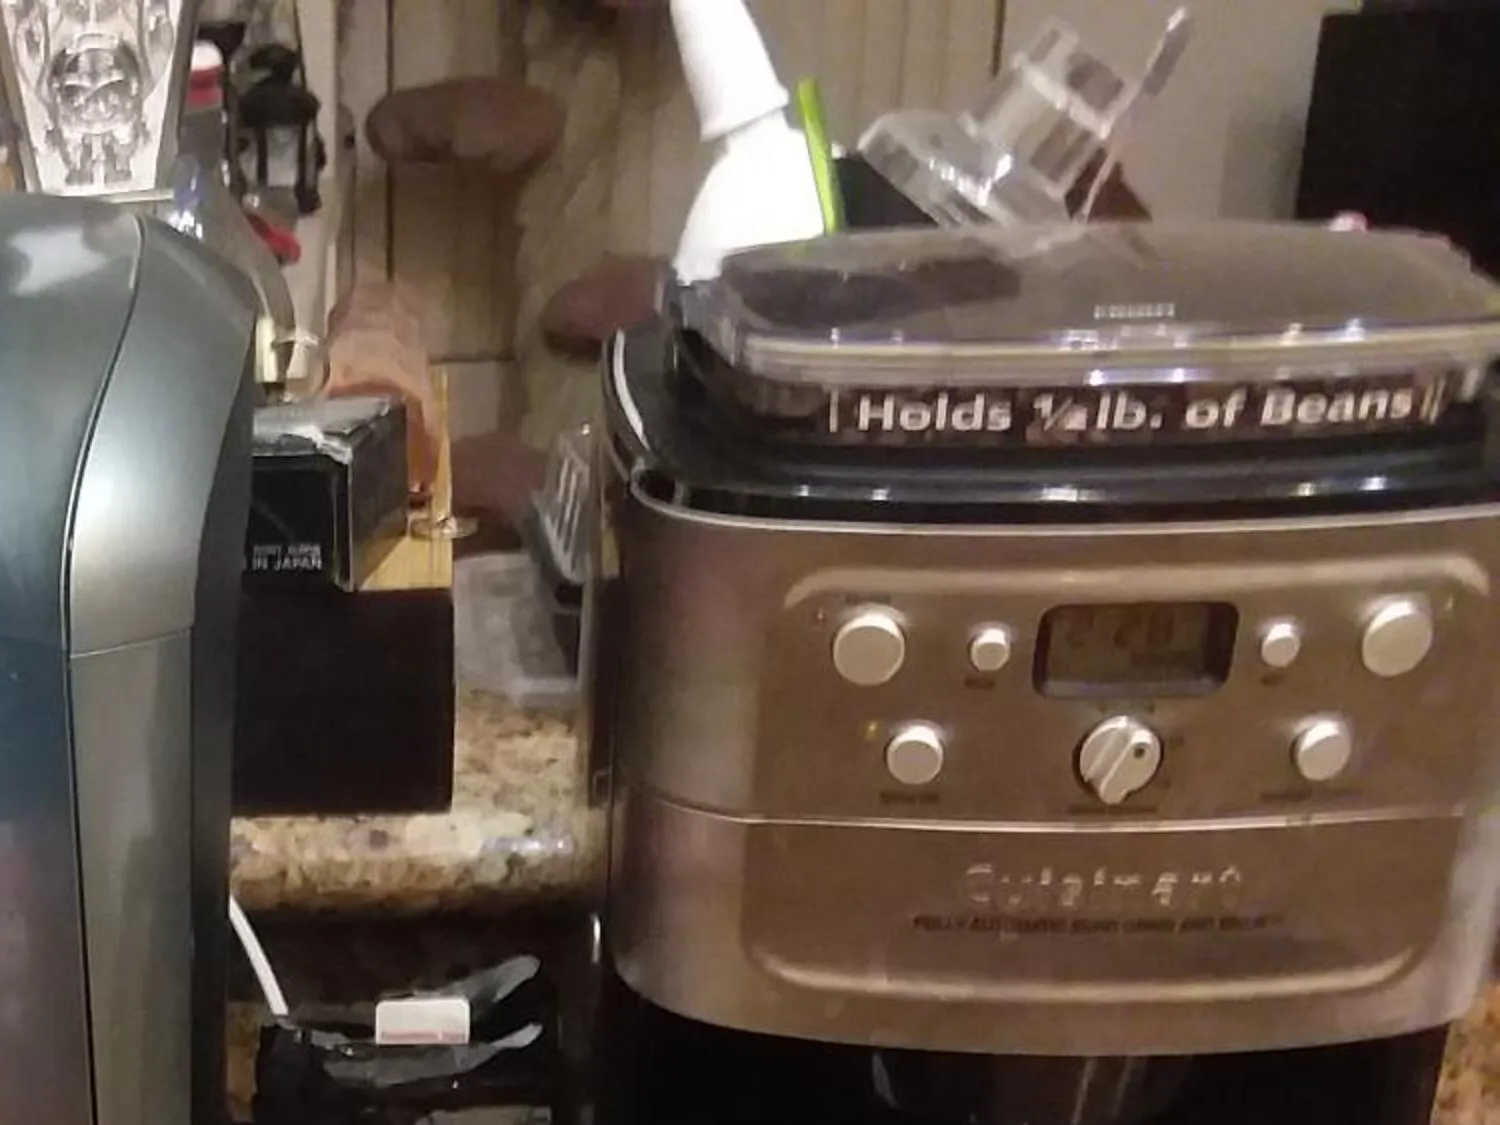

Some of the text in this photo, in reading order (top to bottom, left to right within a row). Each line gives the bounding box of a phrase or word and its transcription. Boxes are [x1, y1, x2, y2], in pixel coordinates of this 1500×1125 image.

[857, 392, 1014, 432] Holds
[1185, 390, 1246, 430] of
[1259, 385, 1414, 428] Beans
